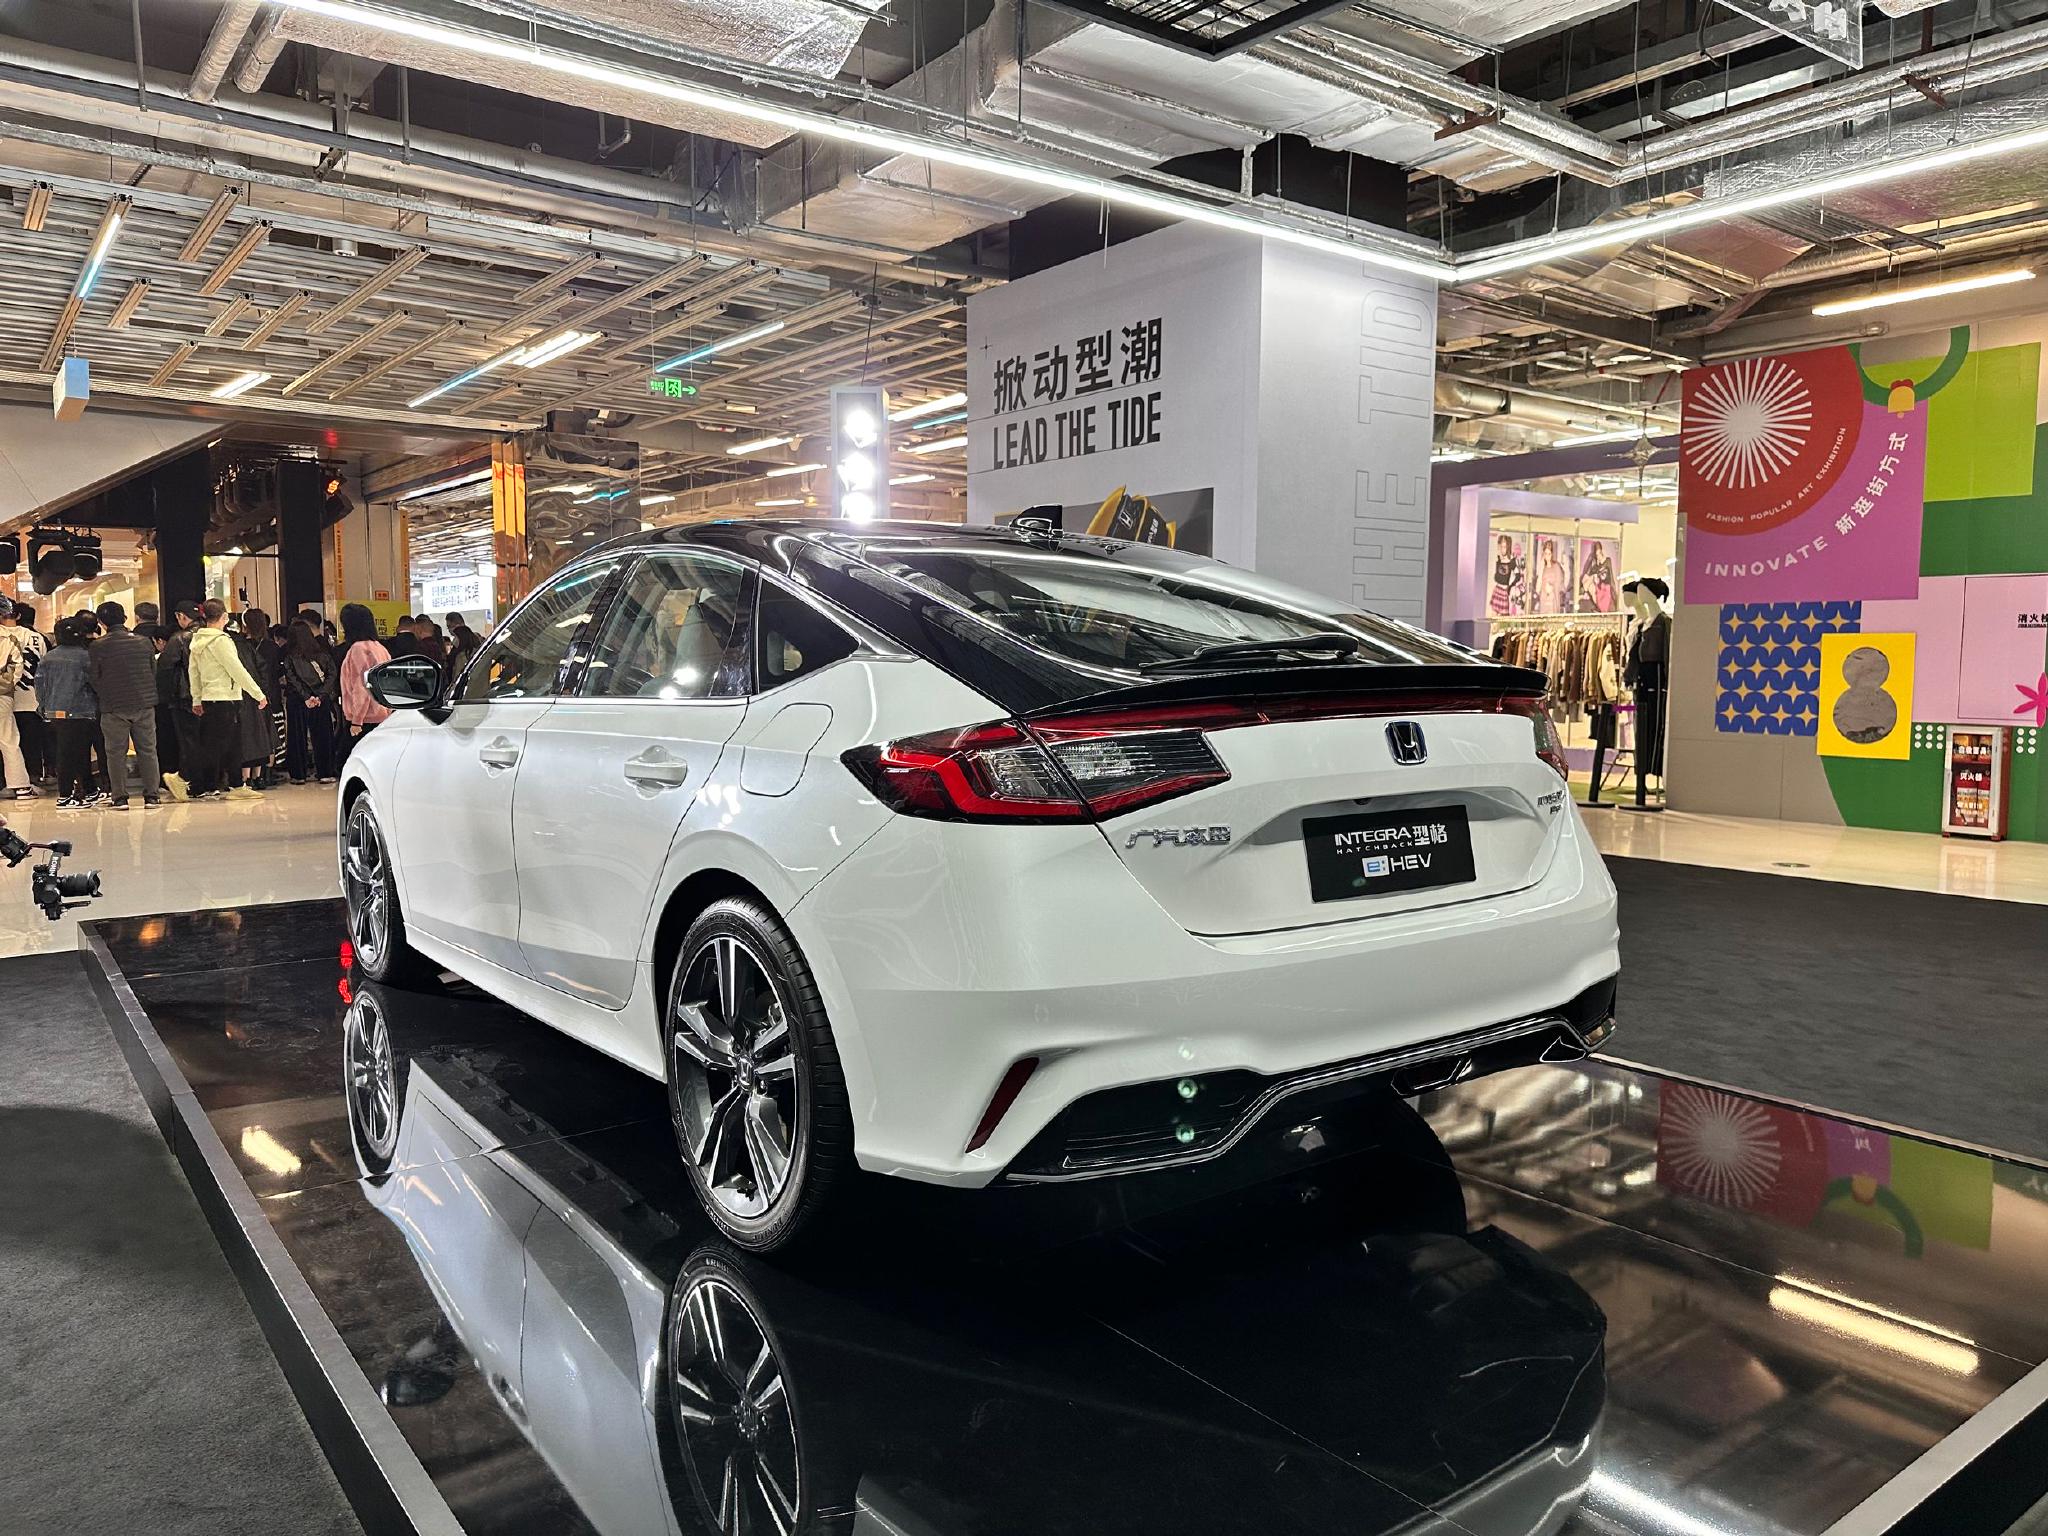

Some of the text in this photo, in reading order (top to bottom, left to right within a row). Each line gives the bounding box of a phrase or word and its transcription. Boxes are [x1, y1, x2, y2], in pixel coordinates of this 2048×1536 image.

[993, 317, 1162, 415] 掀动型潮
[993, 391, 1162, 470] LEAD THE TIDE
[1352, 262, 1435, 619] THE TID
[1706, 427, 1847, 524] FASHION POPULAR ART EXHIBITION
[1705, 431, 1909, 577] INNOVATE 新逛街方式
[1334, 823, 1448, 847] INTEGRA 型格
[1336, 840, 1413, 855] HATCHBACK
